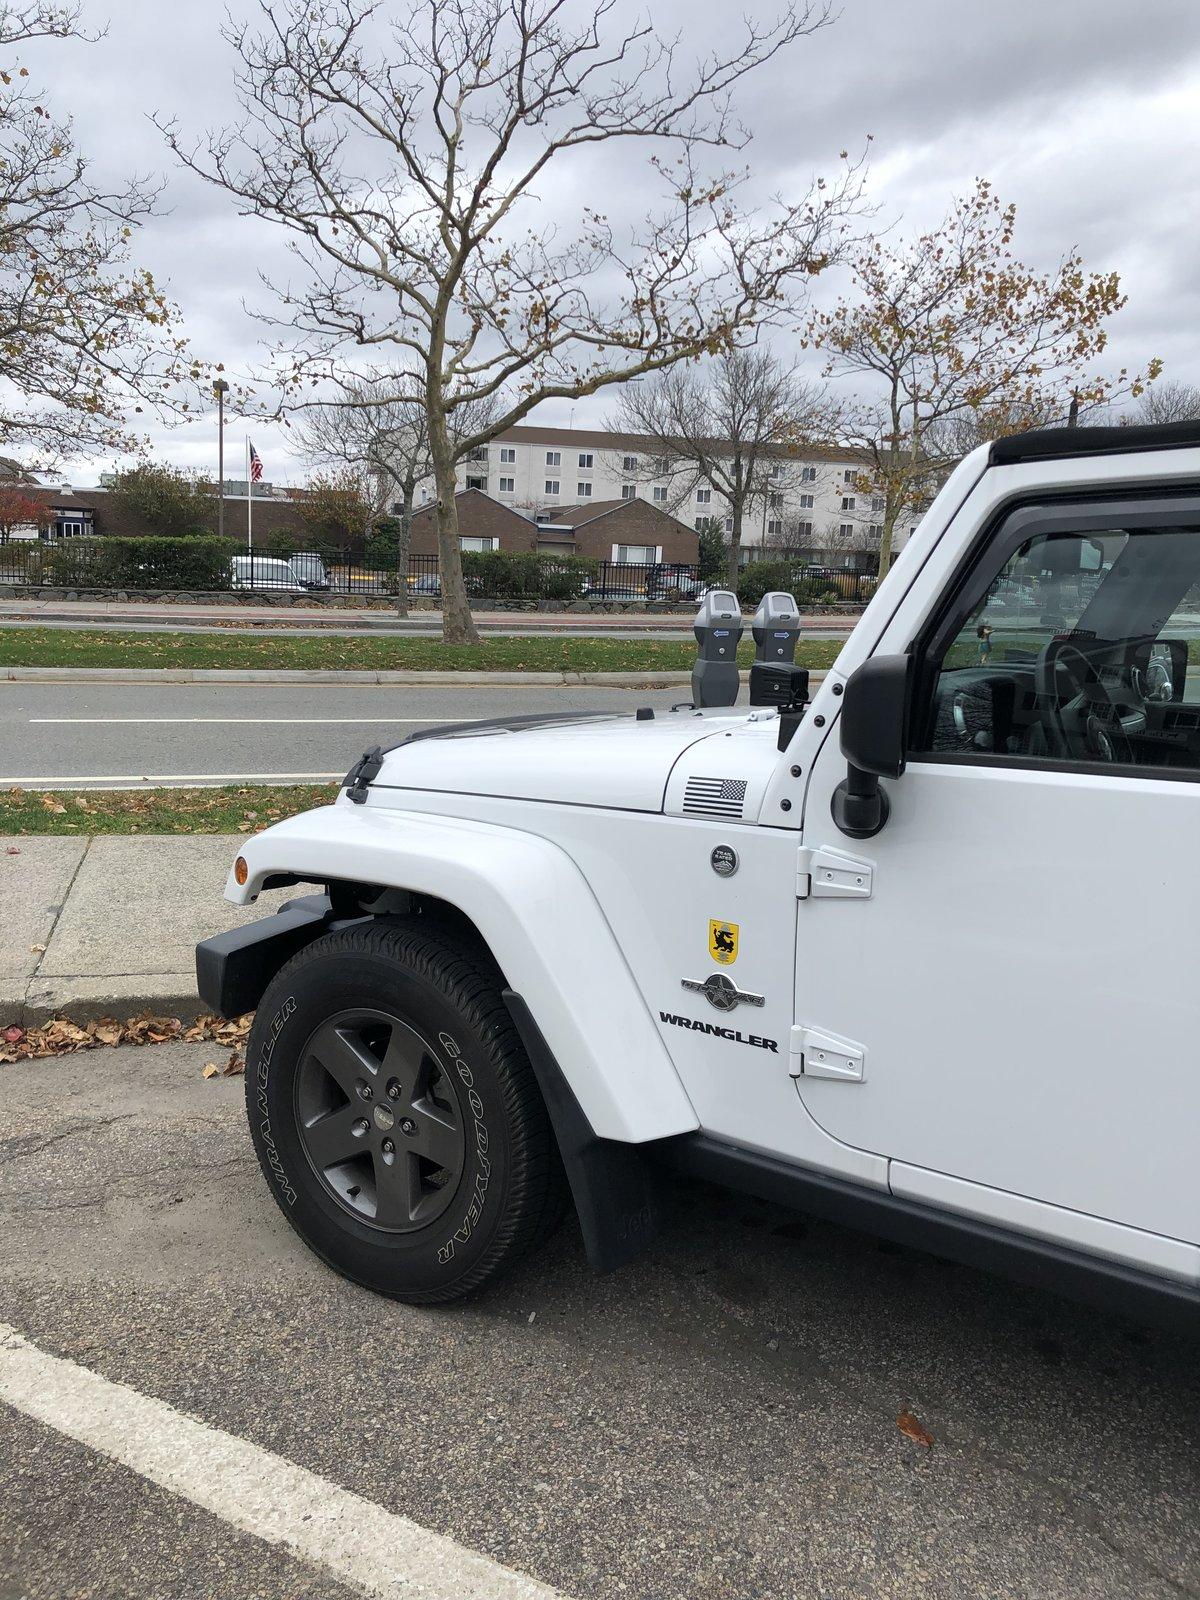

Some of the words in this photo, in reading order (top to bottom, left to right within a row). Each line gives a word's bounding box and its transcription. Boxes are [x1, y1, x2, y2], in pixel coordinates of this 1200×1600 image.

[257, 996, 298, 1206] WRANGLER
[659, 1011, 779, 1054] WRANGLER
[438, 1032, 490, 1264] GOODYEAR
